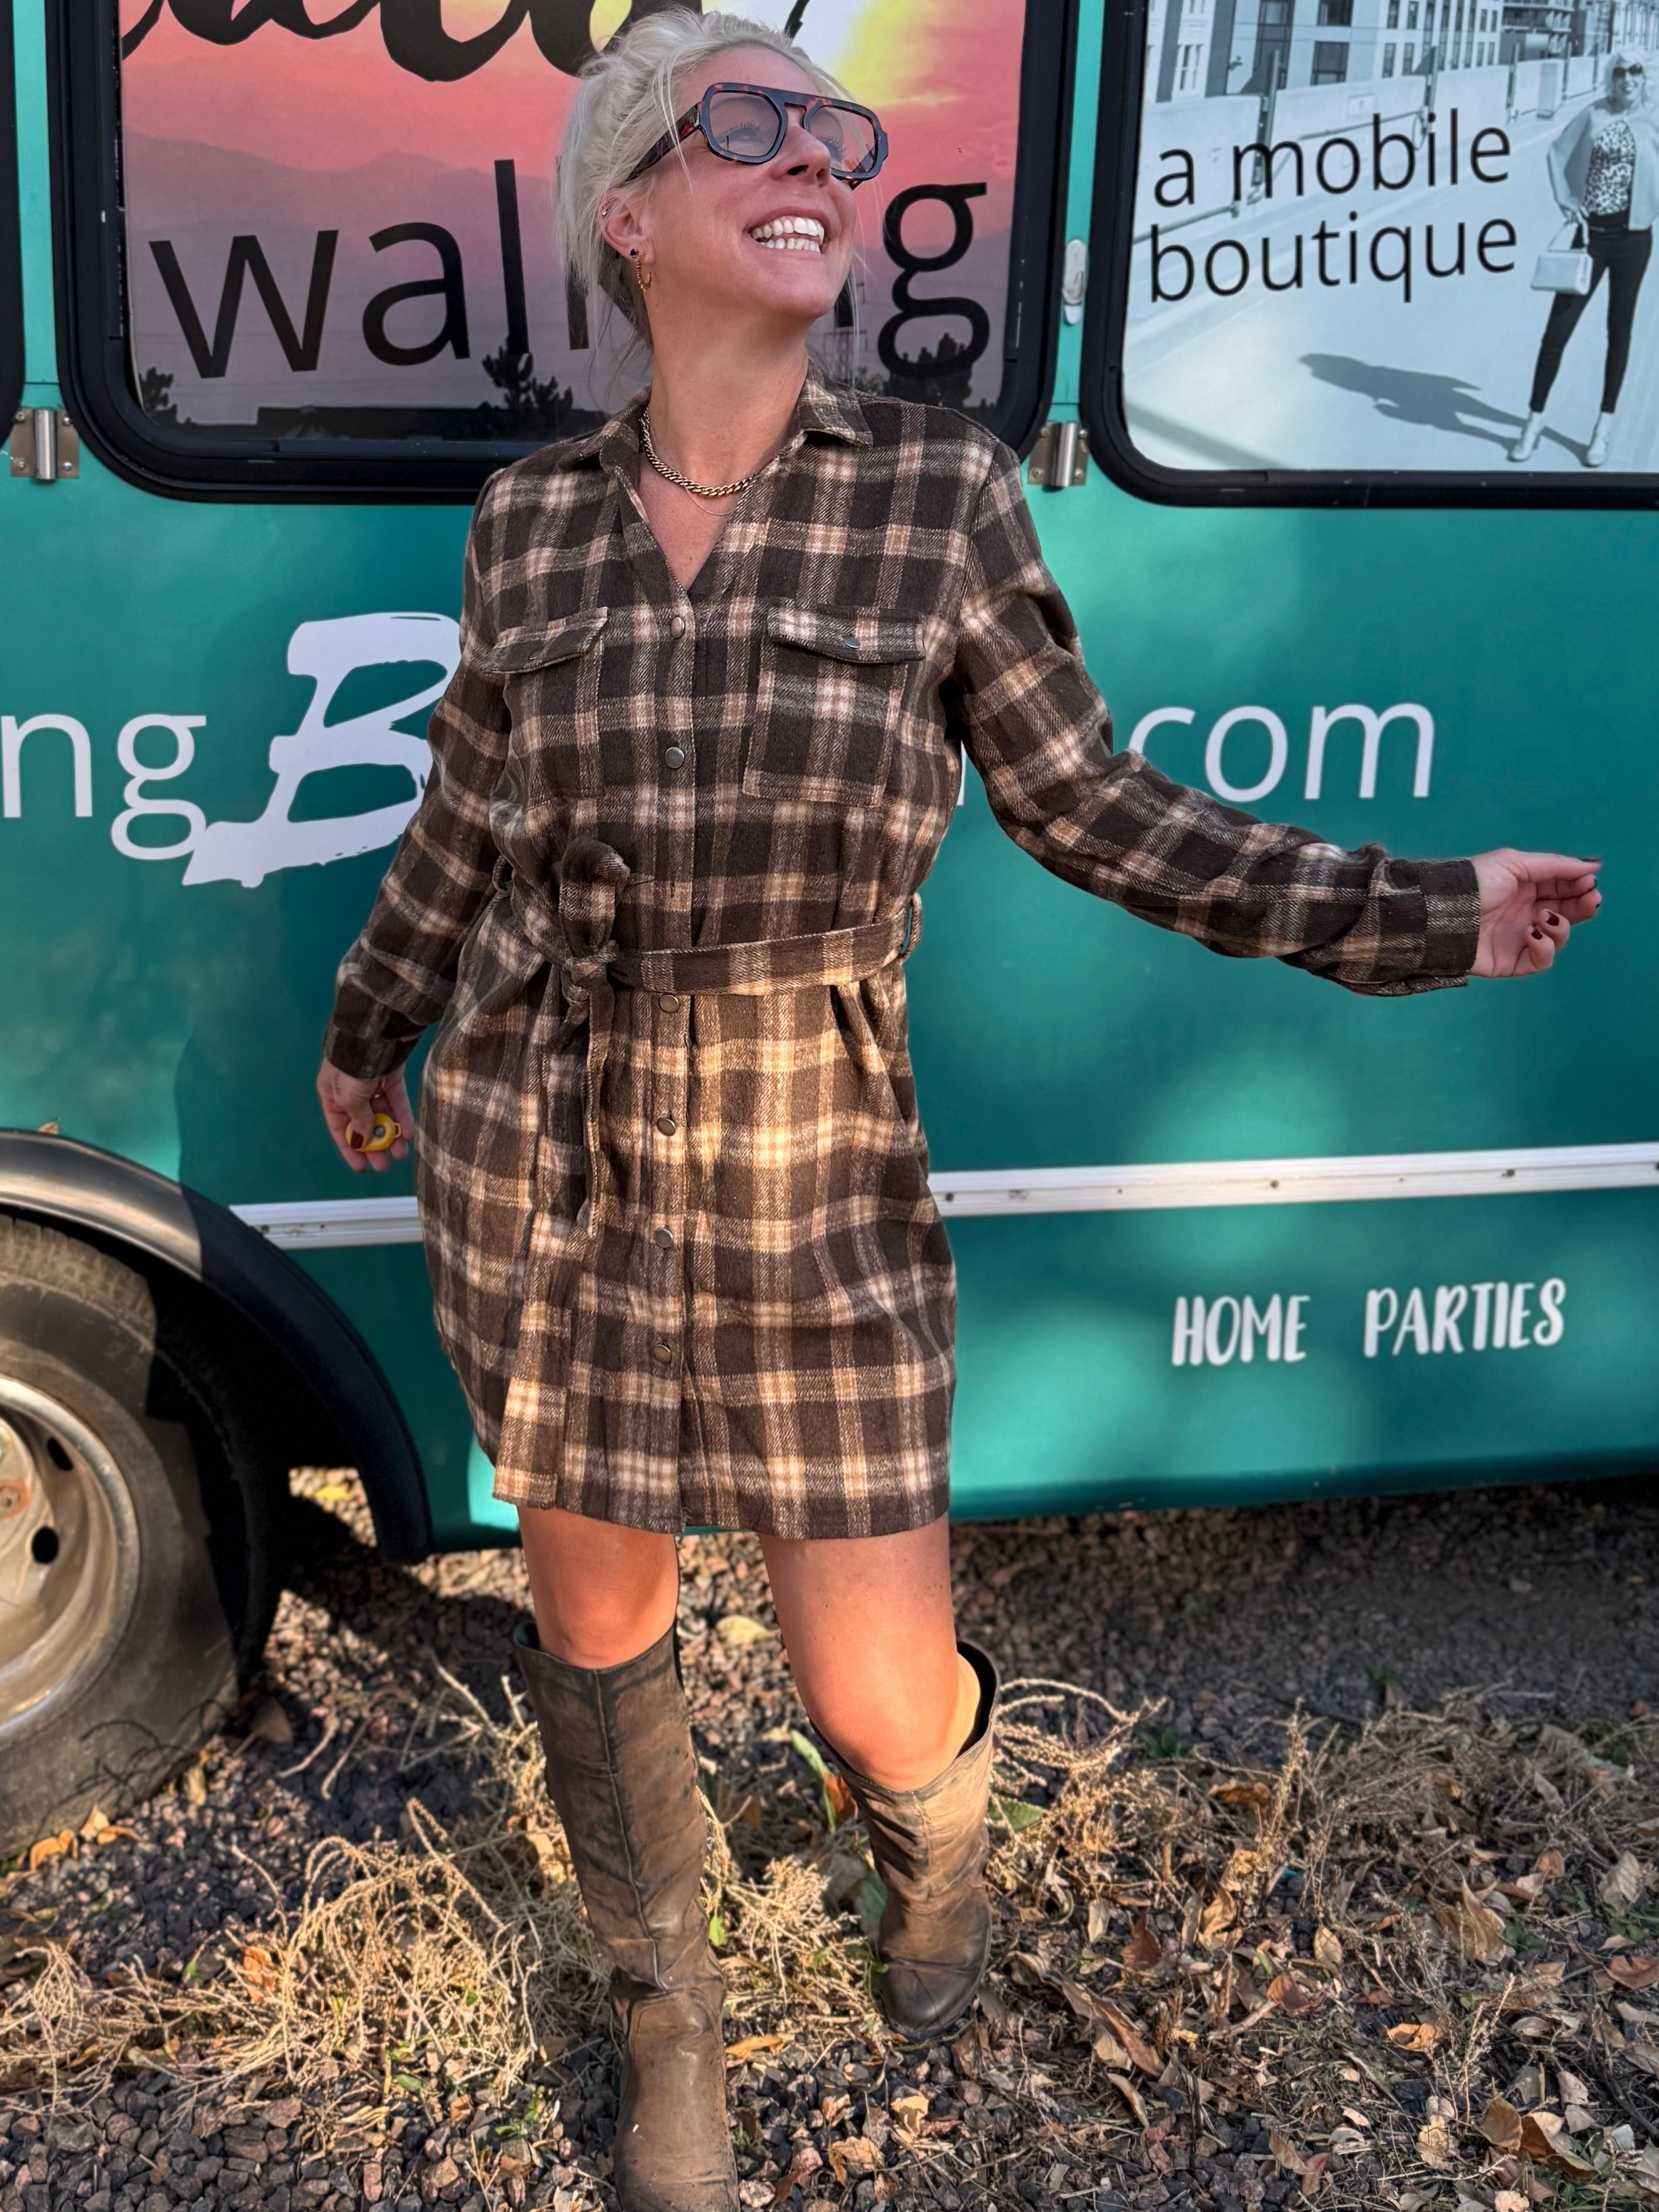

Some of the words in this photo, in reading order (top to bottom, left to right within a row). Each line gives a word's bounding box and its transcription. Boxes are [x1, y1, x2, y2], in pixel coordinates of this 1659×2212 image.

[1153, 148, 1195, 207] a
[1232, 108, 1511, 202] mobile
[148, 159, 990, 379] walg
[1149, 211, 1517, 303] boutique
[1171, 1294, 1311, 1366] HOME
[1363, 1278, 1567, 1357] PARTIES
